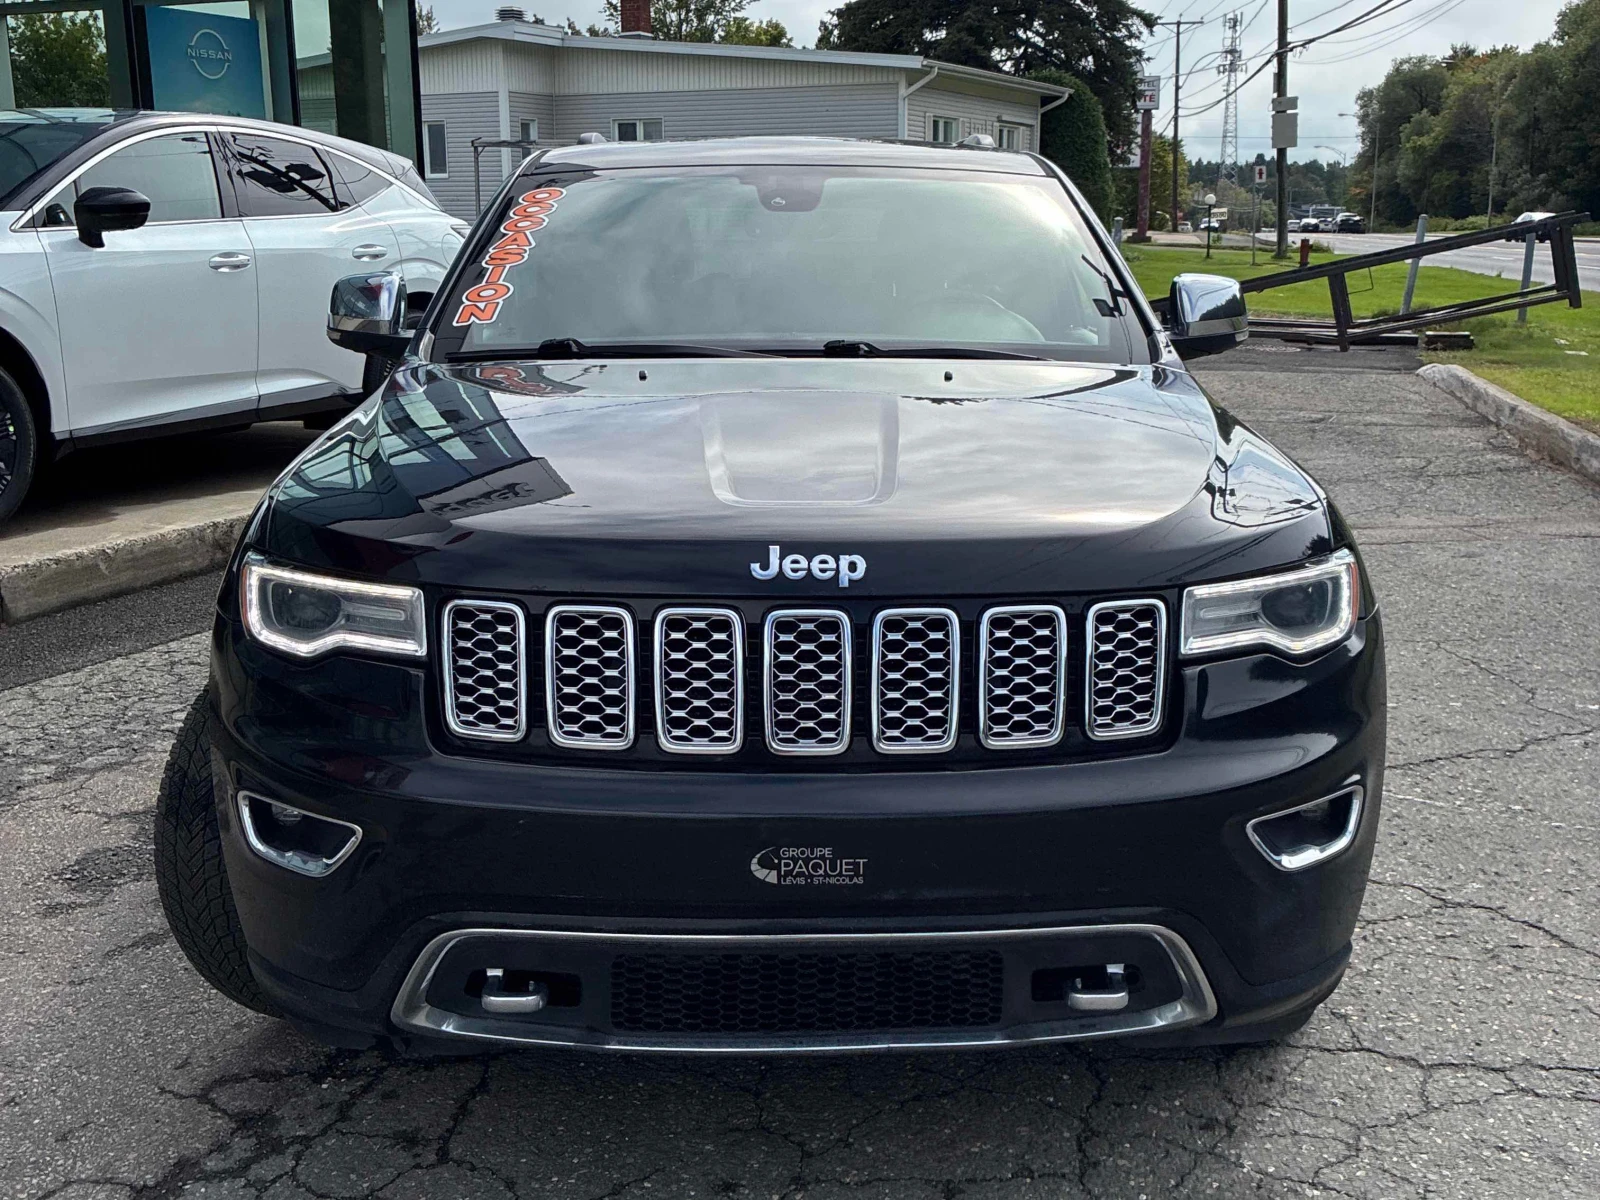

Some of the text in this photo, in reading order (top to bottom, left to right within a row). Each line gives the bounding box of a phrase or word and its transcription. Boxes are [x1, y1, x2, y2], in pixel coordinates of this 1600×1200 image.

[187, 48, 232, 60] NISSAN
[453, 187, 566, 326] OCCASION
[750, 545, 867, 588] Jeep
[780, 847, 833, 858] GROUPE
[781, 859, 868, 875] PAQUET
[813, 876, 864, 885] ST-NICOLAS
